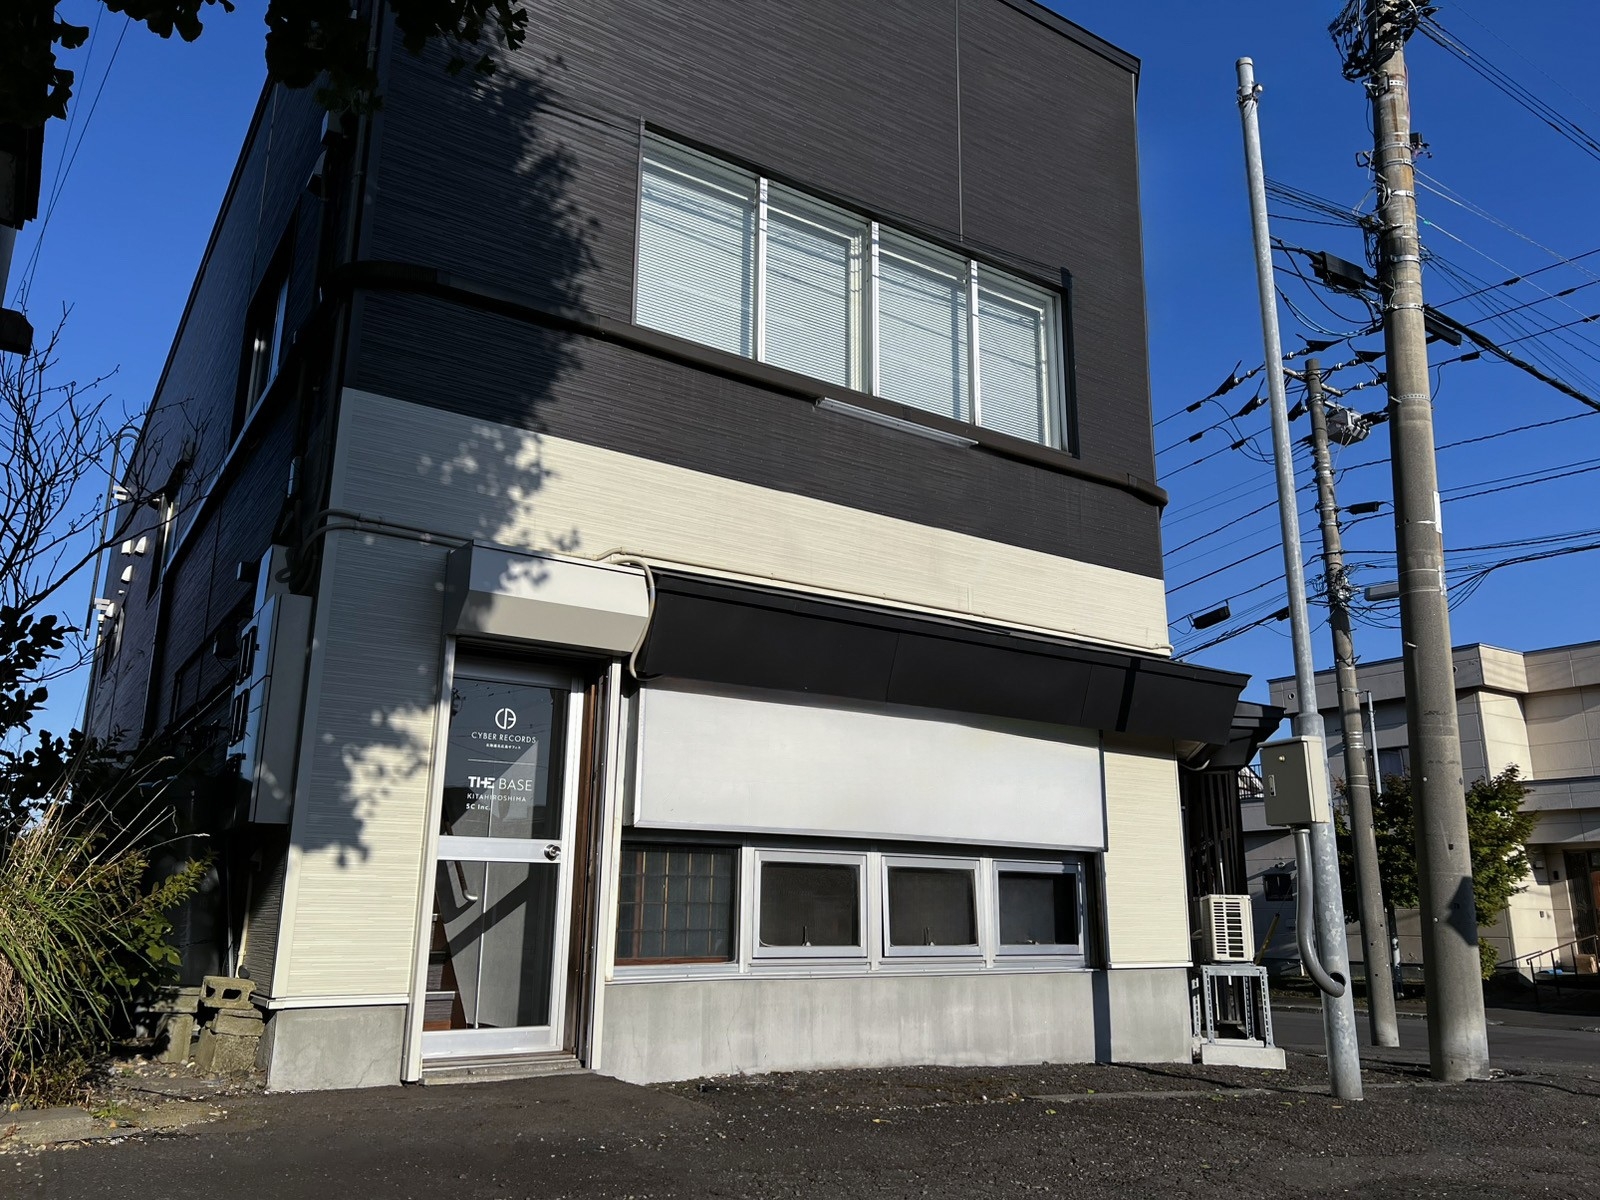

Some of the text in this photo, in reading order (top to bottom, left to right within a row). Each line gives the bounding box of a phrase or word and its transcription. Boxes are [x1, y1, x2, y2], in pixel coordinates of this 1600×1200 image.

[471, 732, 536, 743] CYBER RECORDS
[468, 776, 533, 791] THE BASE
[467, 793, 526, 801] KITAHIROSHIMA
